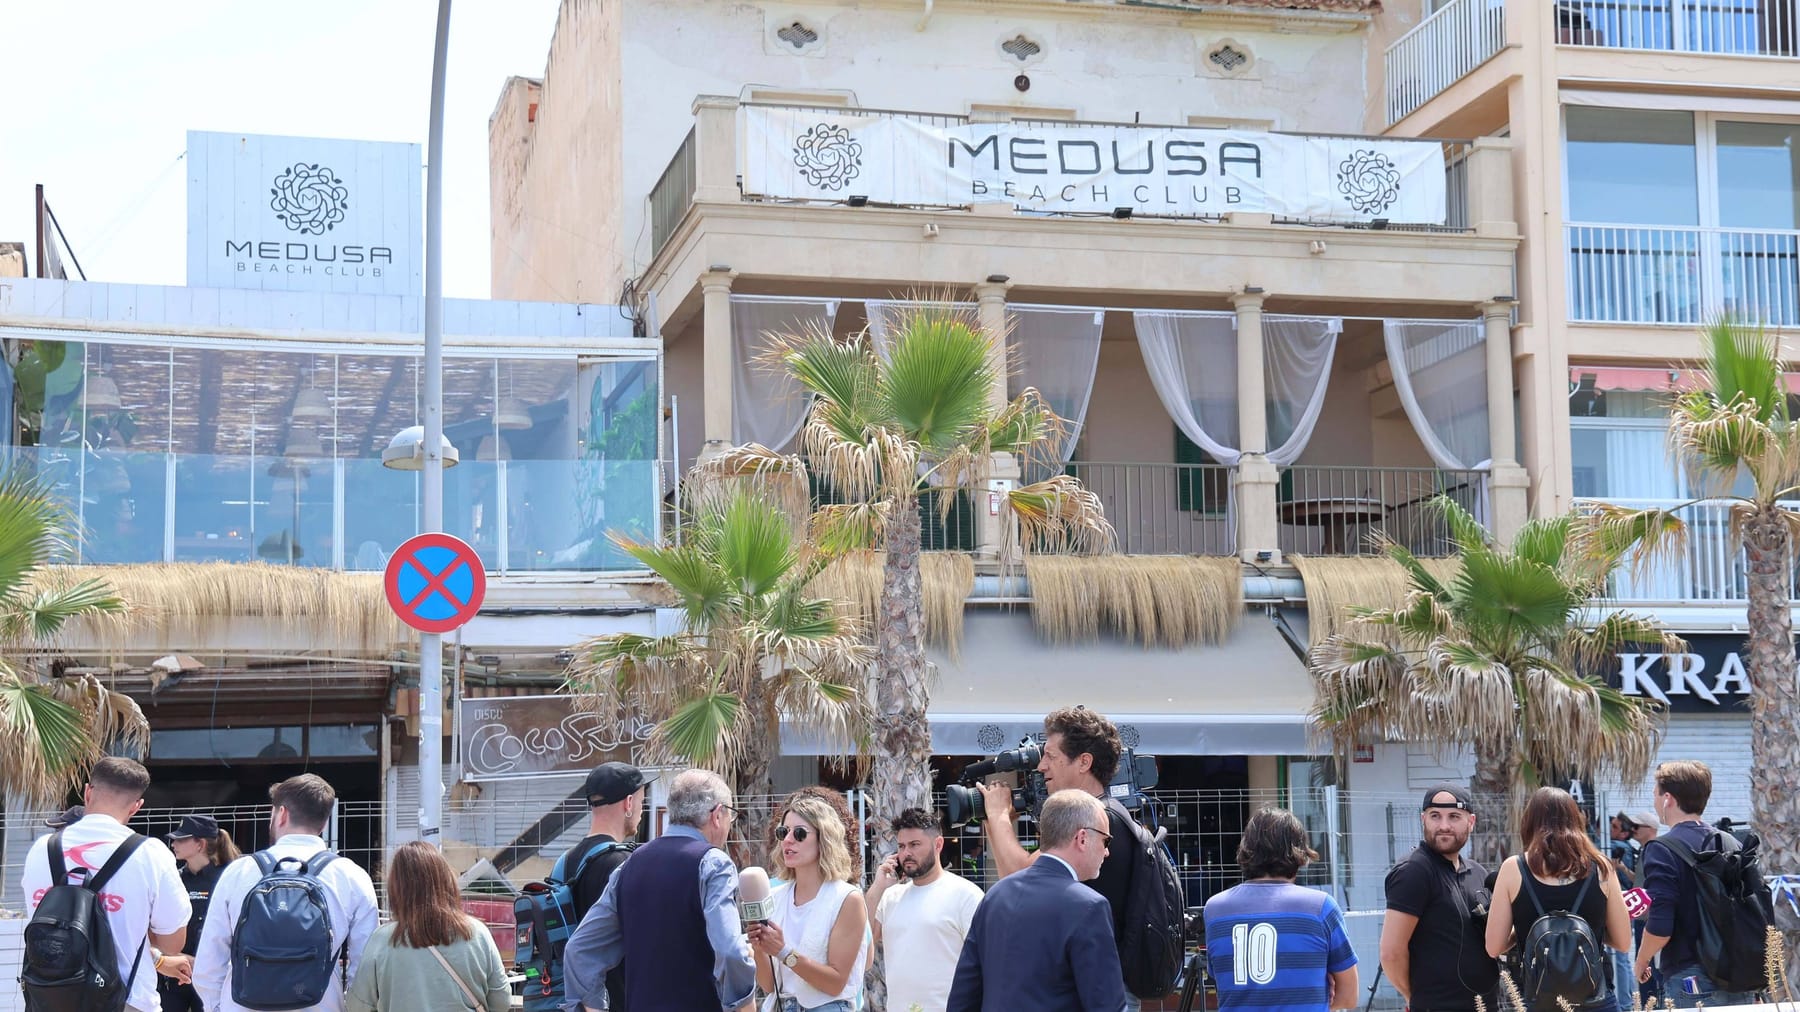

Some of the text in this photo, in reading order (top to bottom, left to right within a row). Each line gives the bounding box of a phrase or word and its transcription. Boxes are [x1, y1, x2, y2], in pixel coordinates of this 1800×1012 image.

[949, 134, 1262, 178] MEDUSA
[971, 179, 1242, 205] BEACH CLUB
[226, 240, 392, 265] MEDUSA
[236, 261, 382, 278] BEACH CLUB
[1616, 652, 1753, 706] KRA
[1232, 922, 1278, 985] 10
